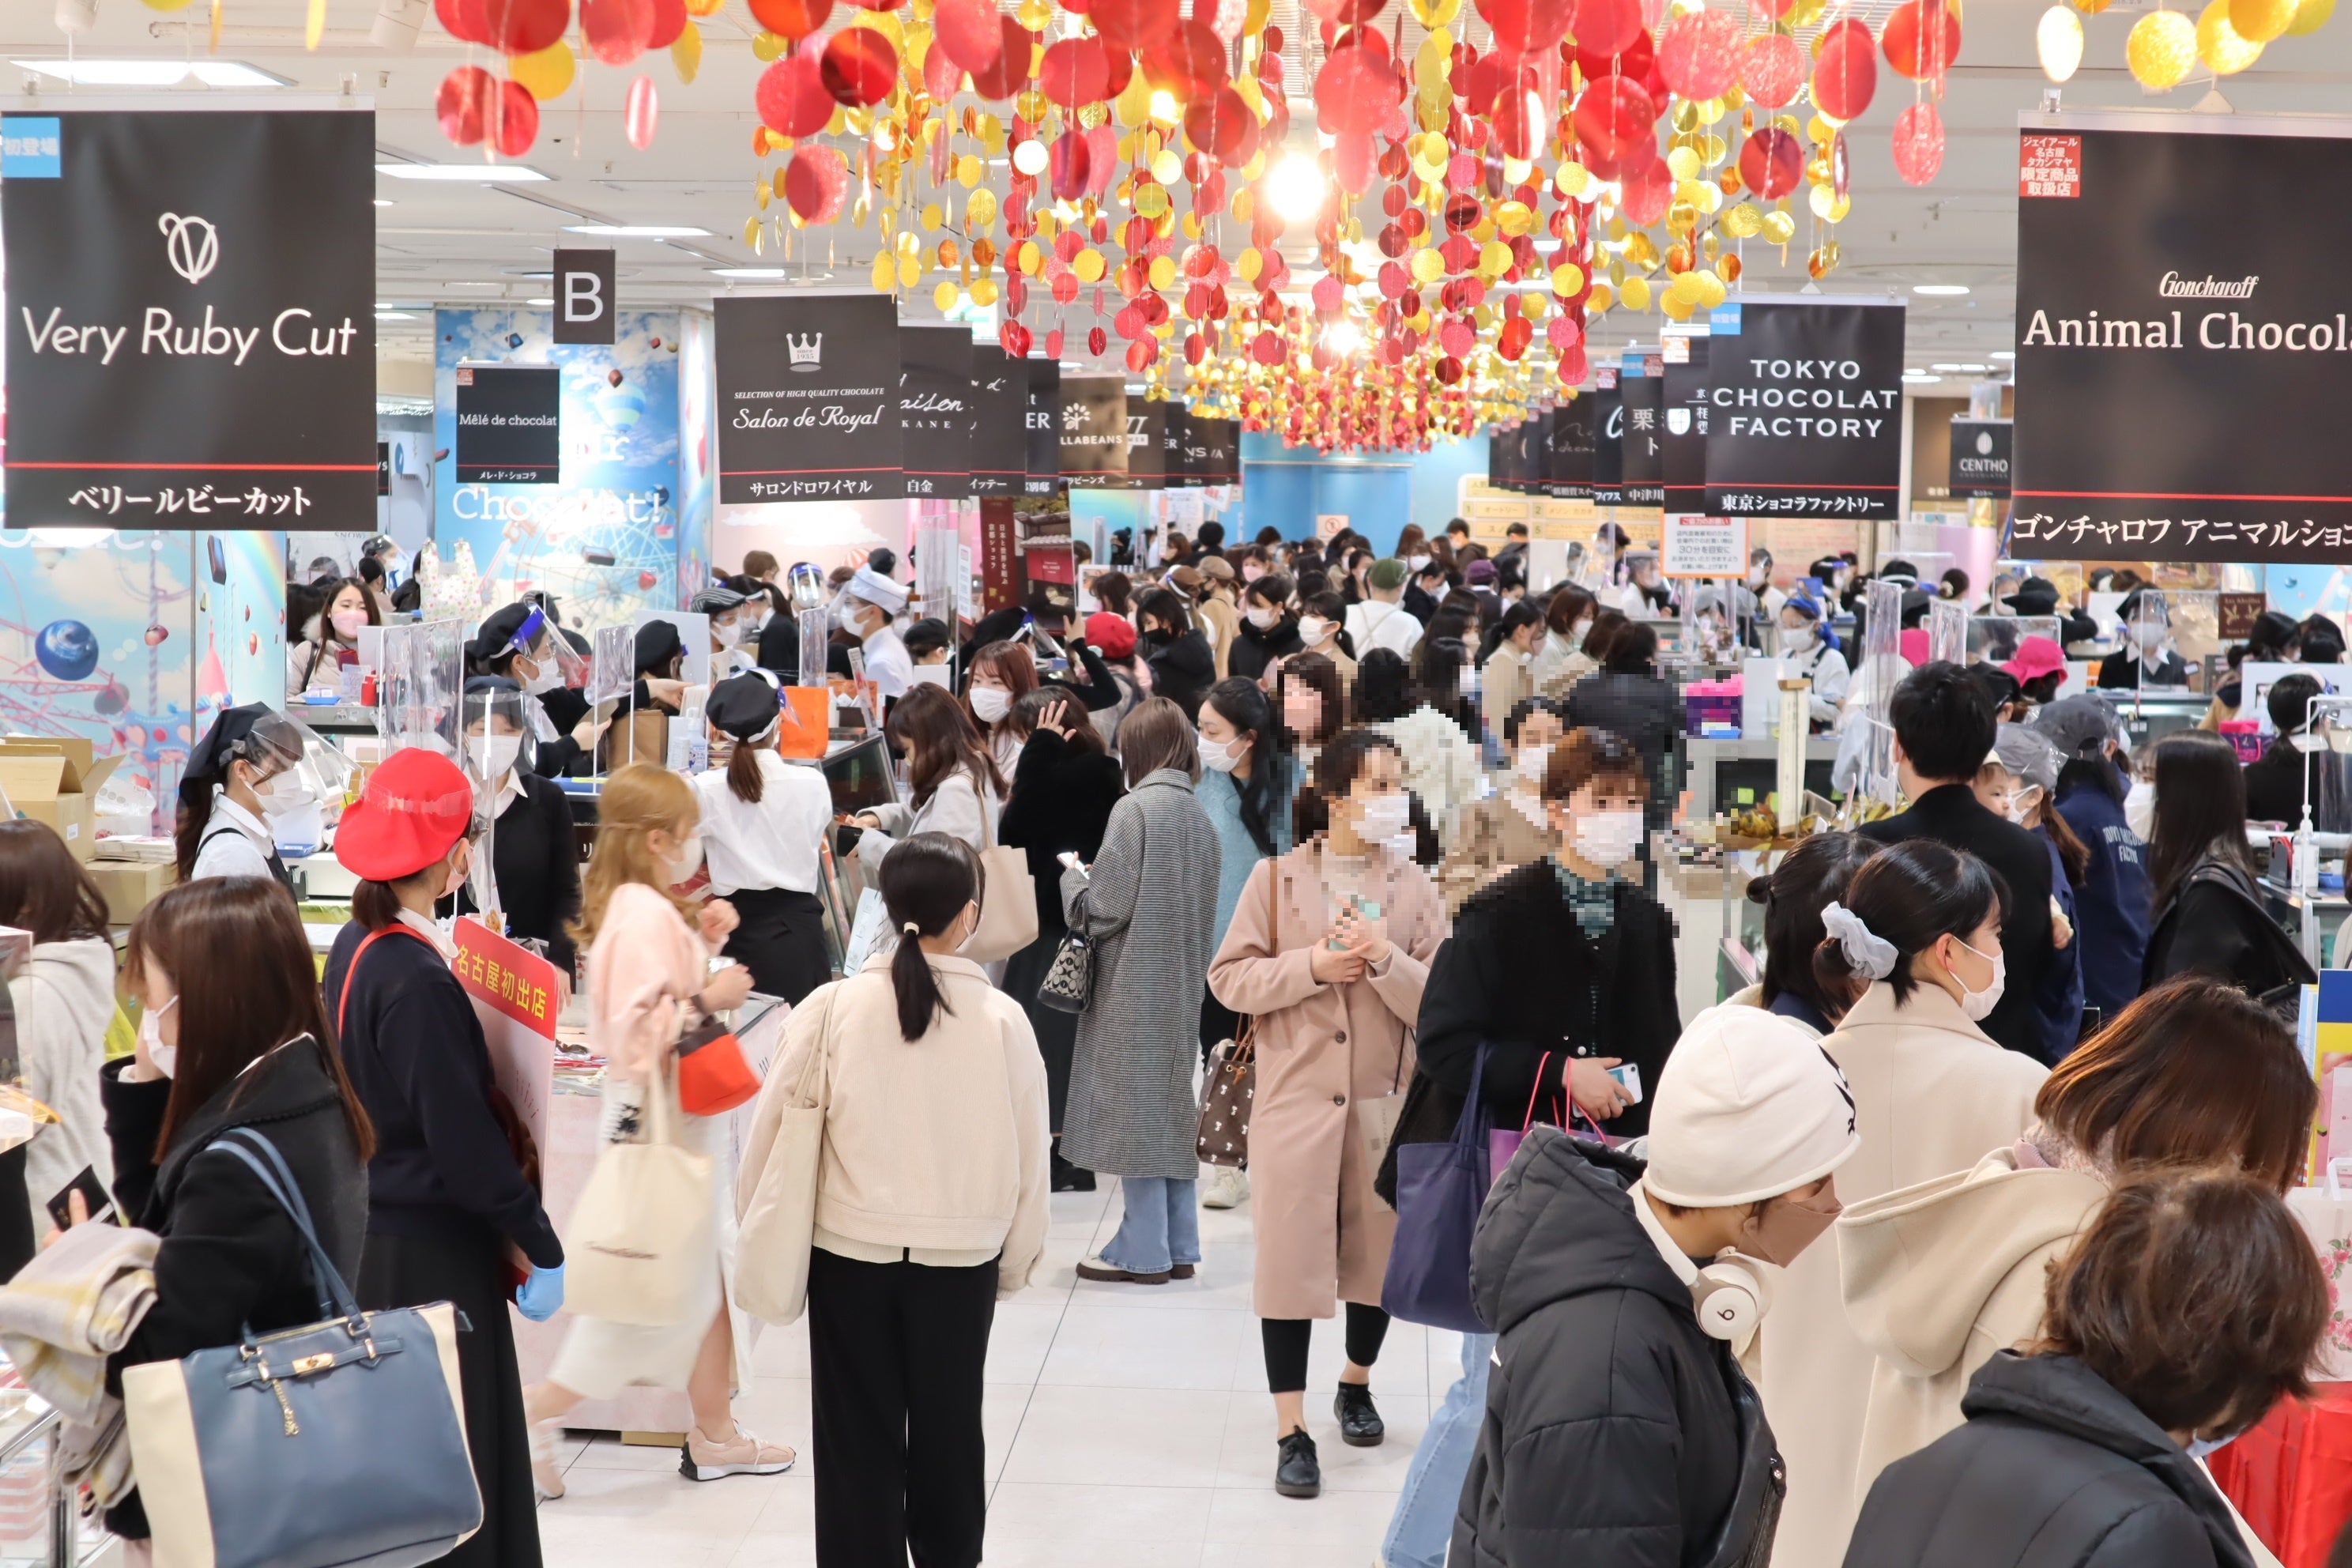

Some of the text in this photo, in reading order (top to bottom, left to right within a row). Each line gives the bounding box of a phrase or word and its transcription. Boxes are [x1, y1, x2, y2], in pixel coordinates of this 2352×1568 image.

[4, 137, 59, 156] 初登場
[2022, 137, 2079, 147] ジェイアール
[2035, 147, 2066, 158] 名古屋
[2026, 157, 2073, 168] タカシマヤ
[2020, 167, 2079, 182] 限定商品
[2026, 181, 2071, 196] 取扱店
[2159, 270, 2260, 299] Goncharoff
[564, 271, 604, 322] B
[22, 305, 357, 366] Very Ruby Cut
[2022, 309, 2352, 351] Animal Chocol
[1750, 359, 1860, 380] TOKYO
[807, 389, 839, 399] QUALITY
[839, 387, 884, 396] CHOCOLATE
[1713, 387, 1898, 409] CHOCOLAT
[458, 413, 557, 426] Mêlé de chocolat
[733, 405, 885, 433] Salon de Royal
[1730, 416, 1883, 438] FACTORY
[1060, 435, 1123, 445] LLABEANS
[1959, 458, 2008, 473] CENTHO
[479, 471, 537, 481] メレ・ド・ショコラ
[749, 479, 873, 497] サロンドロワイヤル
[907, 479, 933, 493] 白金
[68, 484, 311, 516] ベリールビーカット
[1721, 493, 1885, 513] 東京ショコラファクトリー
[1535, 505, 1542, 515] 2
[2013, 513, 2172, 545] ゴンチャロフ
[1679, 545, 1731, 554] 30分を目安に
[456, 943, 548, 1021] 名古屋初出店
